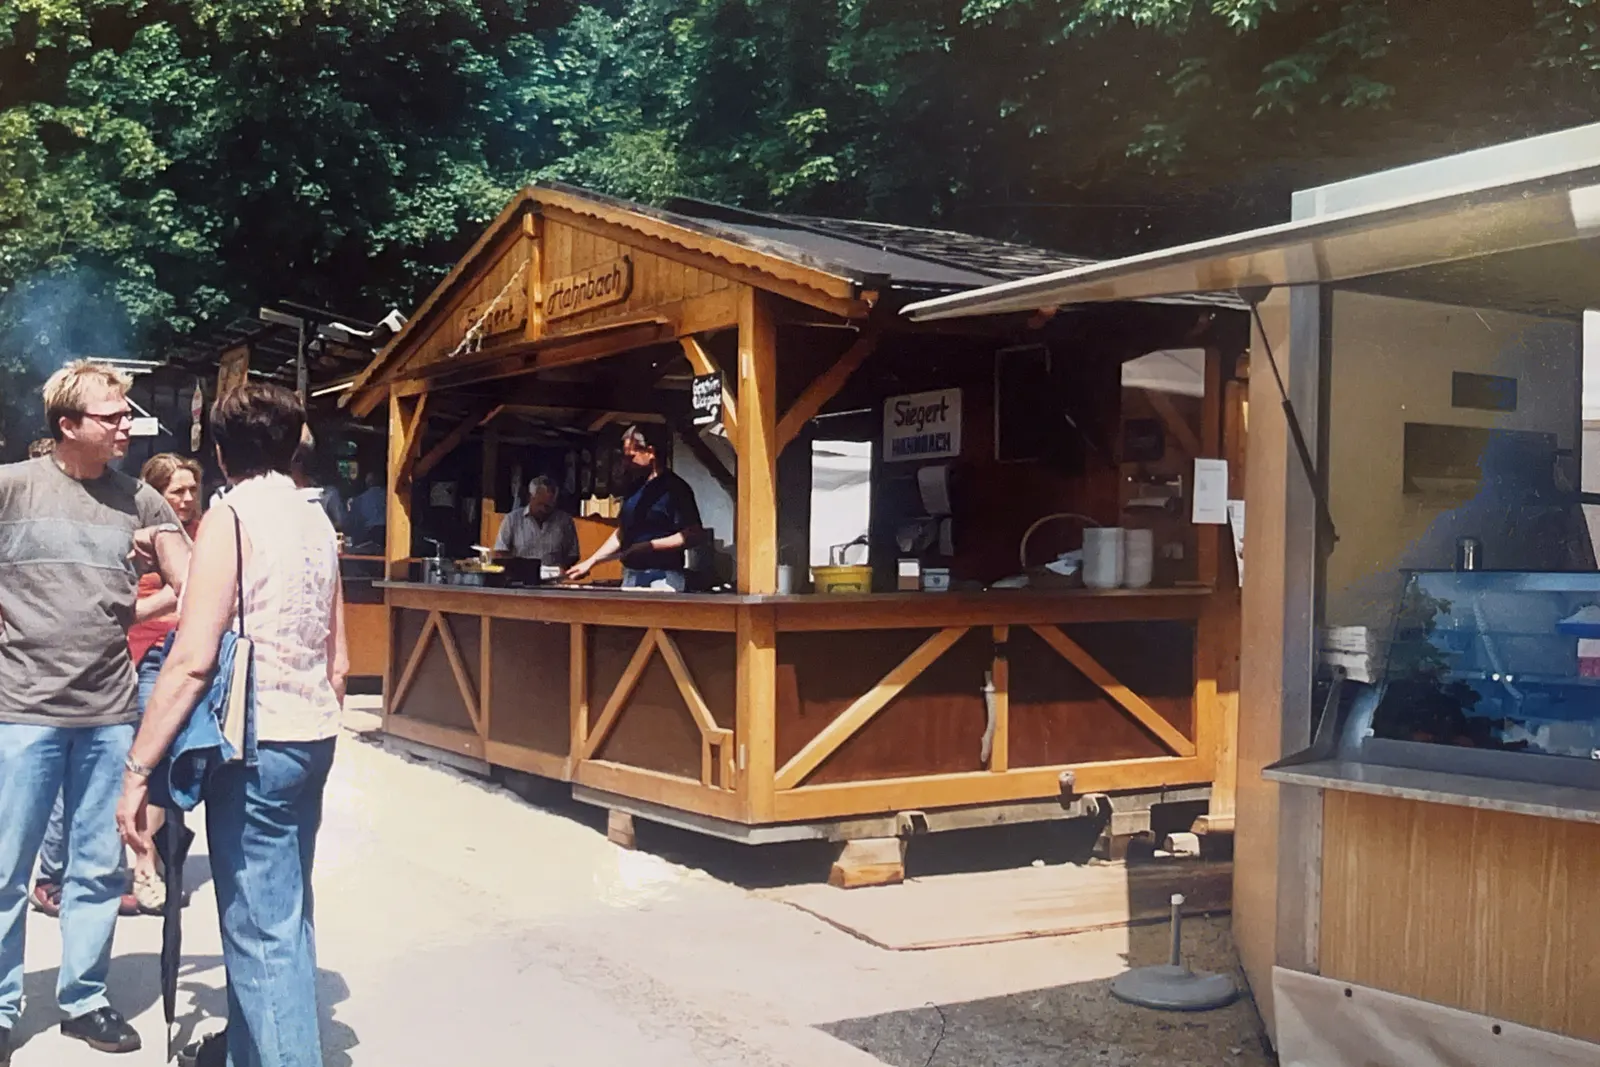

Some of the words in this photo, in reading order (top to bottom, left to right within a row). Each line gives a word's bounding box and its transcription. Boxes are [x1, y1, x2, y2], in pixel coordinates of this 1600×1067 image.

[547, 264, 621, 315] Hahnbach
[466, 299, 515, 332] Sgert
[894, 395, 949, 432] Siegert
